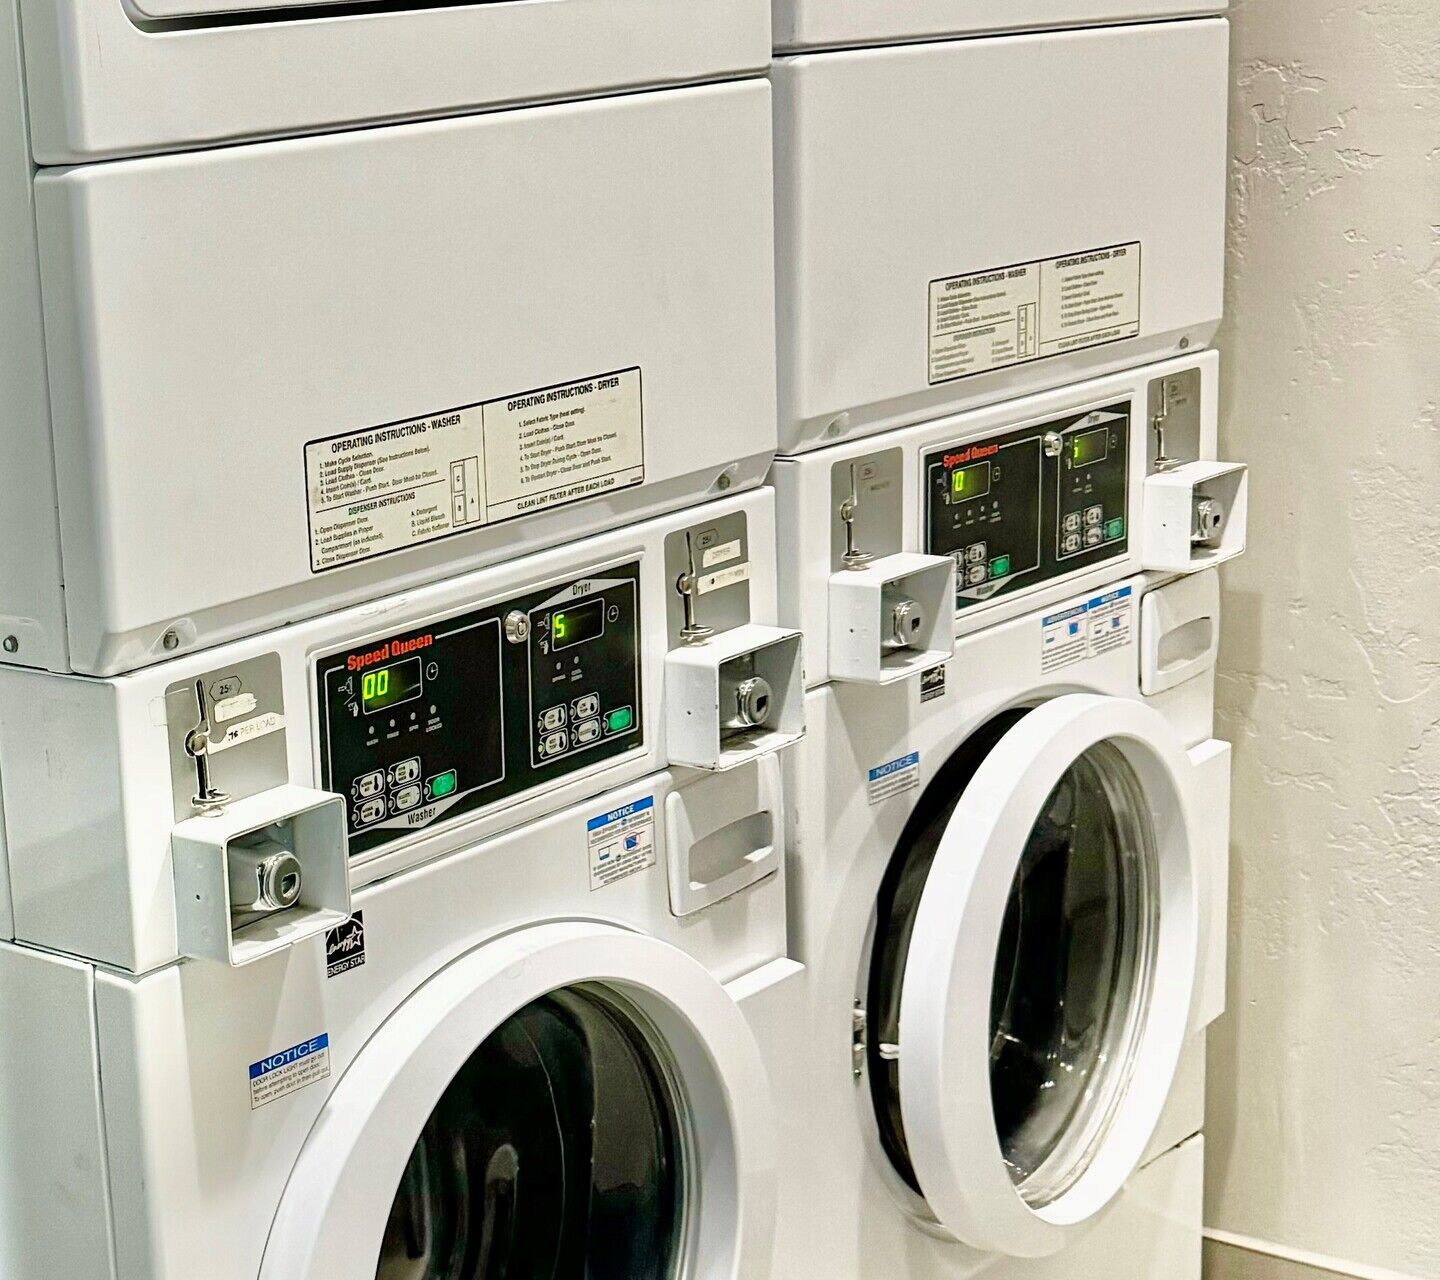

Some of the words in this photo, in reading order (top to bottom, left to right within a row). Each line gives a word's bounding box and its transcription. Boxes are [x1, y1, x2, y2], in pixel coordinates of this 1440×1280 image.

[508, 393, 545, 412] OPERATING
[547, 383, 593, 402] INSTRUCTIONS
[598, 377, 619, 391] DRYER
[331, 435, 373, 453] OPERATING
[375, 422, 426, 443] INSTRUCTIONS
[431, 414, 460, 429] WASHER
[944, 448, 970, 468] Speed
[971, 444, 998, 459] Queen
[348, 502, 378, 515] DISPENSER
[379, 492, 415, 508] INSTRUCTIONS
[517, 501, 535, 509] CLEAN
[537, 496, 548, 504] LINT
[549, 491, 566, 501] FILTER
[568, 486, 584, 496] AFTER
[586, 482, 599, 491] EACH
[601, 478, 615, 487] LOAD
[573, 583, 590, 595] Dryer
[348, 644, 389, 671] Speed
[391, 635, 432, 656] Queen
[364, 670, 388, 700] 00
[876, 755, 912, 777] NOTICE
[408, 807, 436, 824] Washer
[607, 804, 634, 821] NOTICE
[328, 961, 349, 976] ENERGY
[261, 1039, 318, 1073] NOTICE
